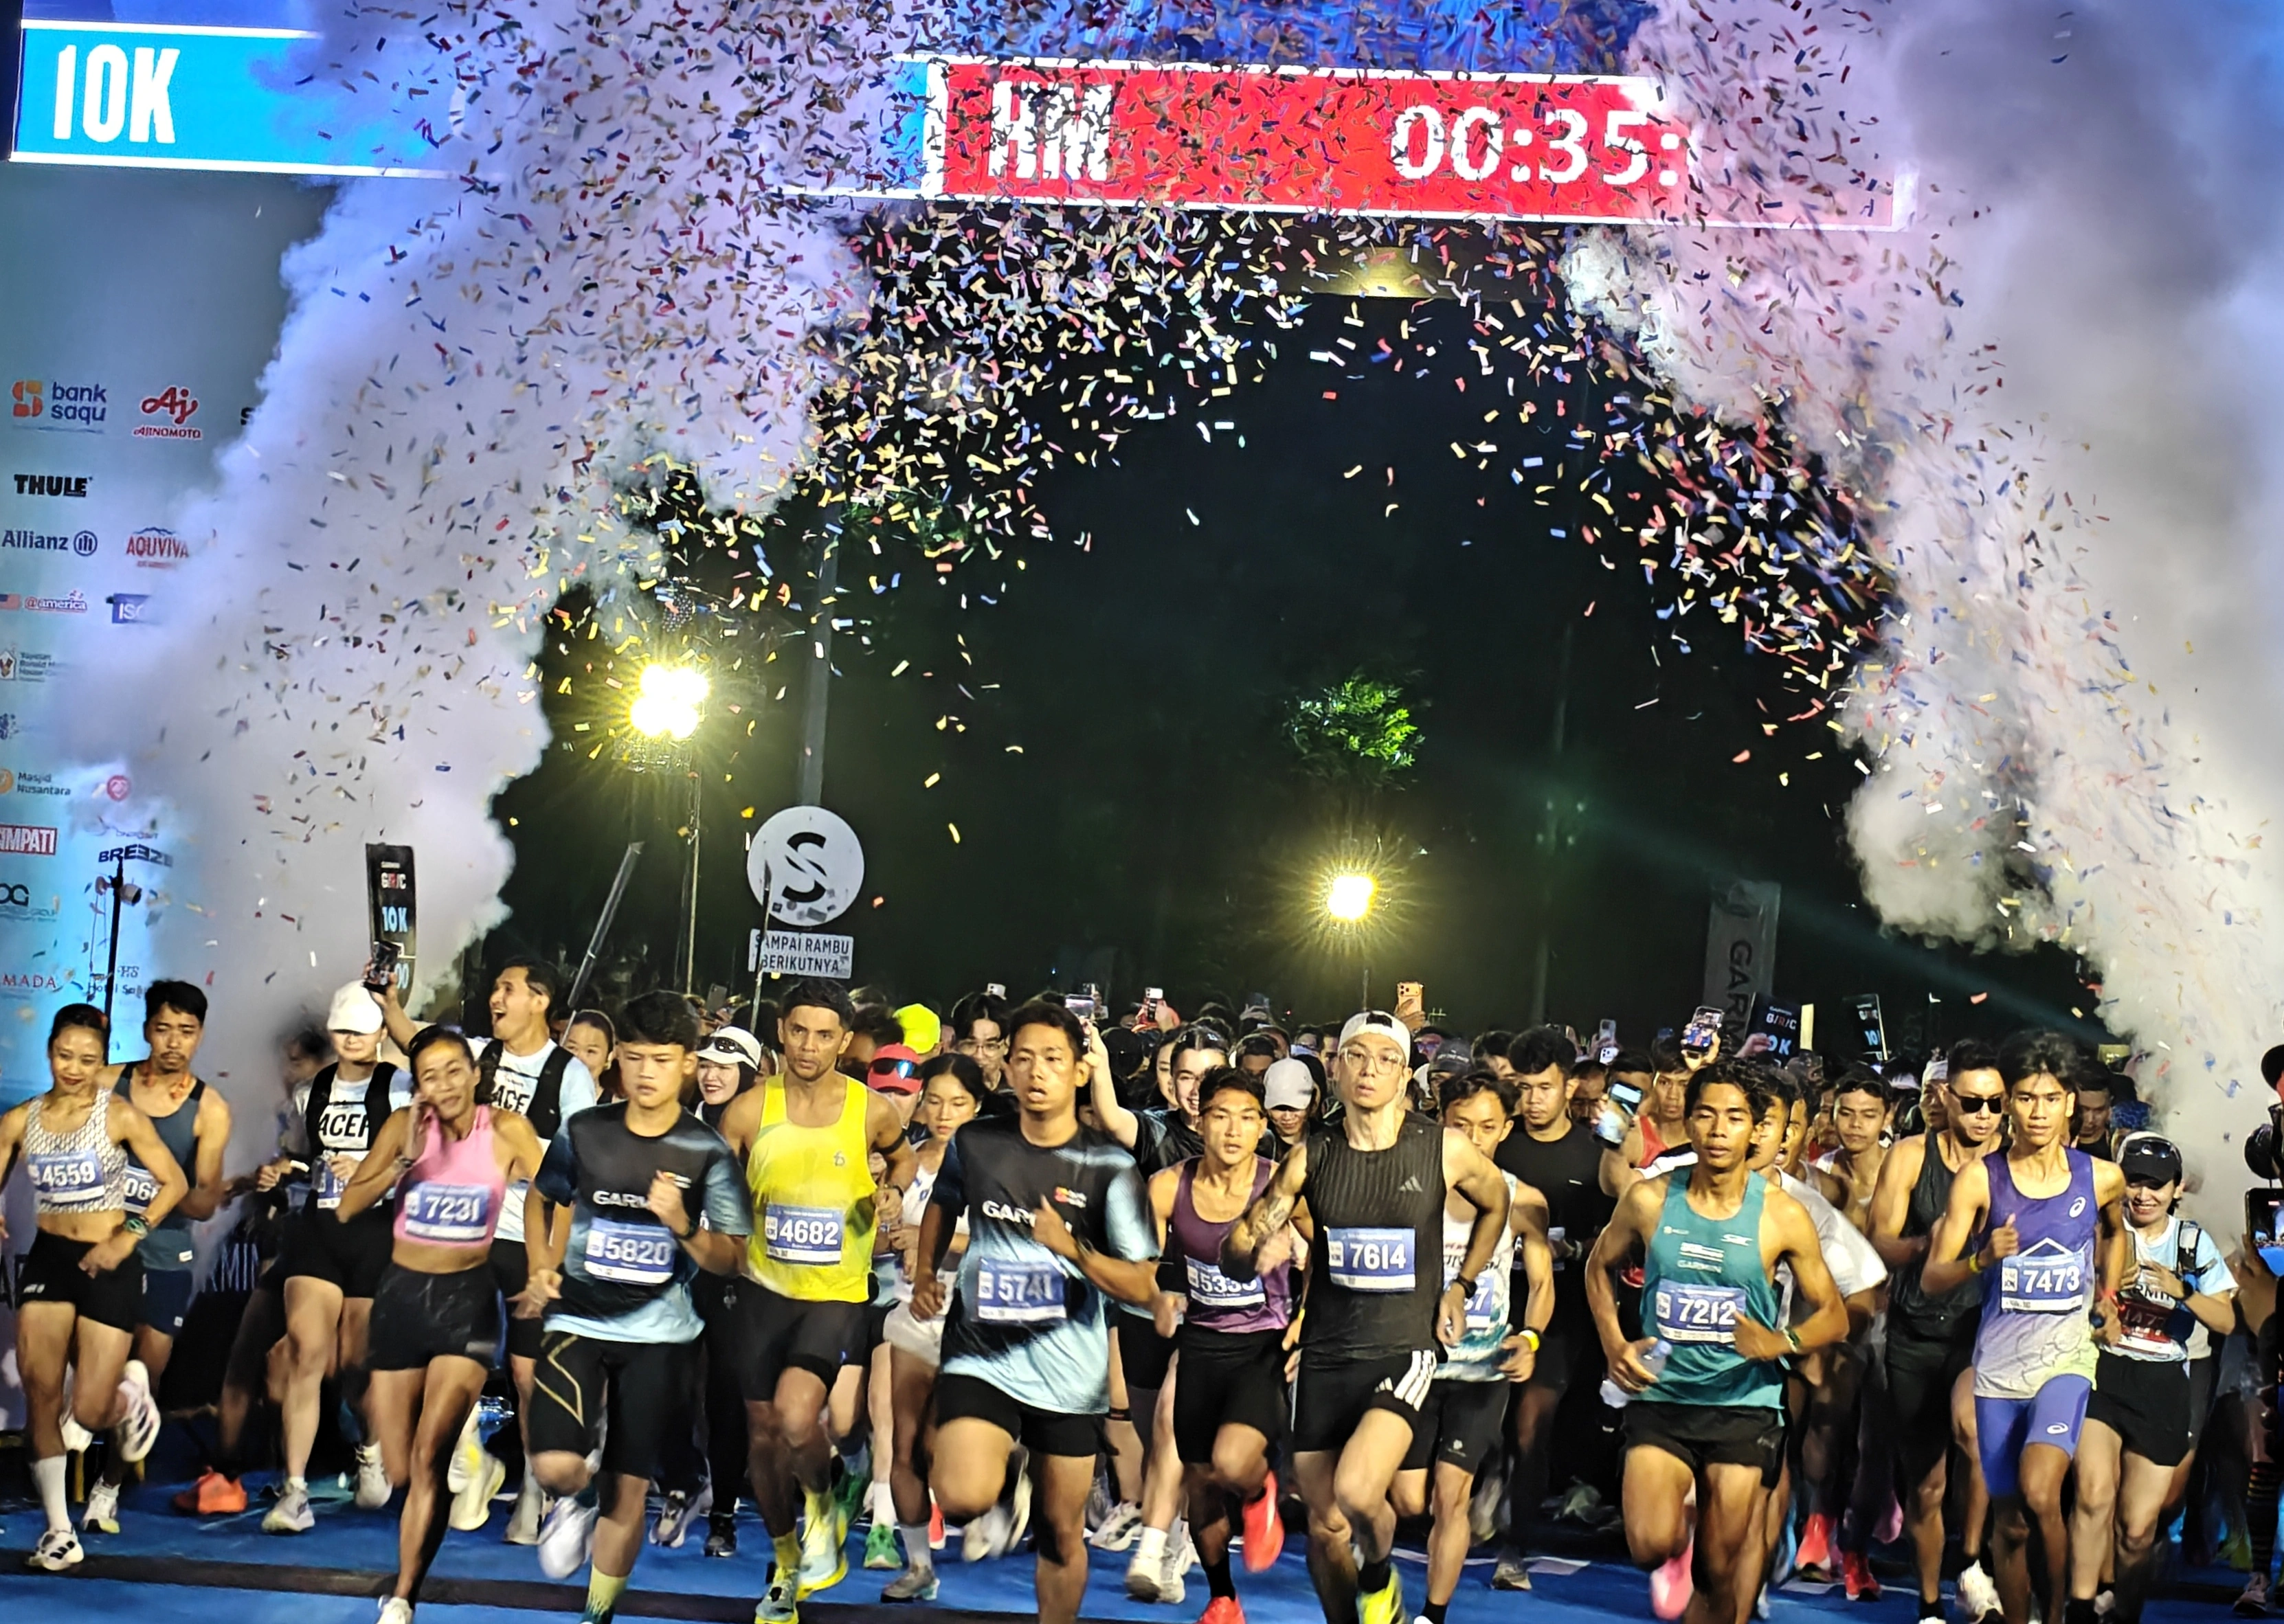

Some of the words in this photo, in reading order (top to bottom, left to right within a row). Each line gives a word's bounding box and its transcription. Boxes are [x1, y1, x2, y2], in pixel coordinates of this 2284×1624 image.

[53, 43, 181, 144] 10K
[52, 381, 107, 403] bank
[51, 404, 107, 425] saqu
[133, 425, 202, 440] AJINOMOTO
[14, 474, 89, 497] THULE
[1, 530, 69, 551] Allianz
[18, 771, 52, 784] Masjid
[17, 784, 71, 796] Nusantara
[381, 905, 409, 933] 10K
[805, 938, 849, 955] RAMBU
[762, 954, 840, 973] BERIKUTNYA
[42, 1160, 96, 1187] 4559
[779, 1219, 839, 1245] 4682
[604, 1236, 671, 1265] 5820
[1350, 1243, 1407, 1270] 7614
[2023, 1265, 2081, 1294] 7473
[1677, 1297, 1738, 1325] 7212
